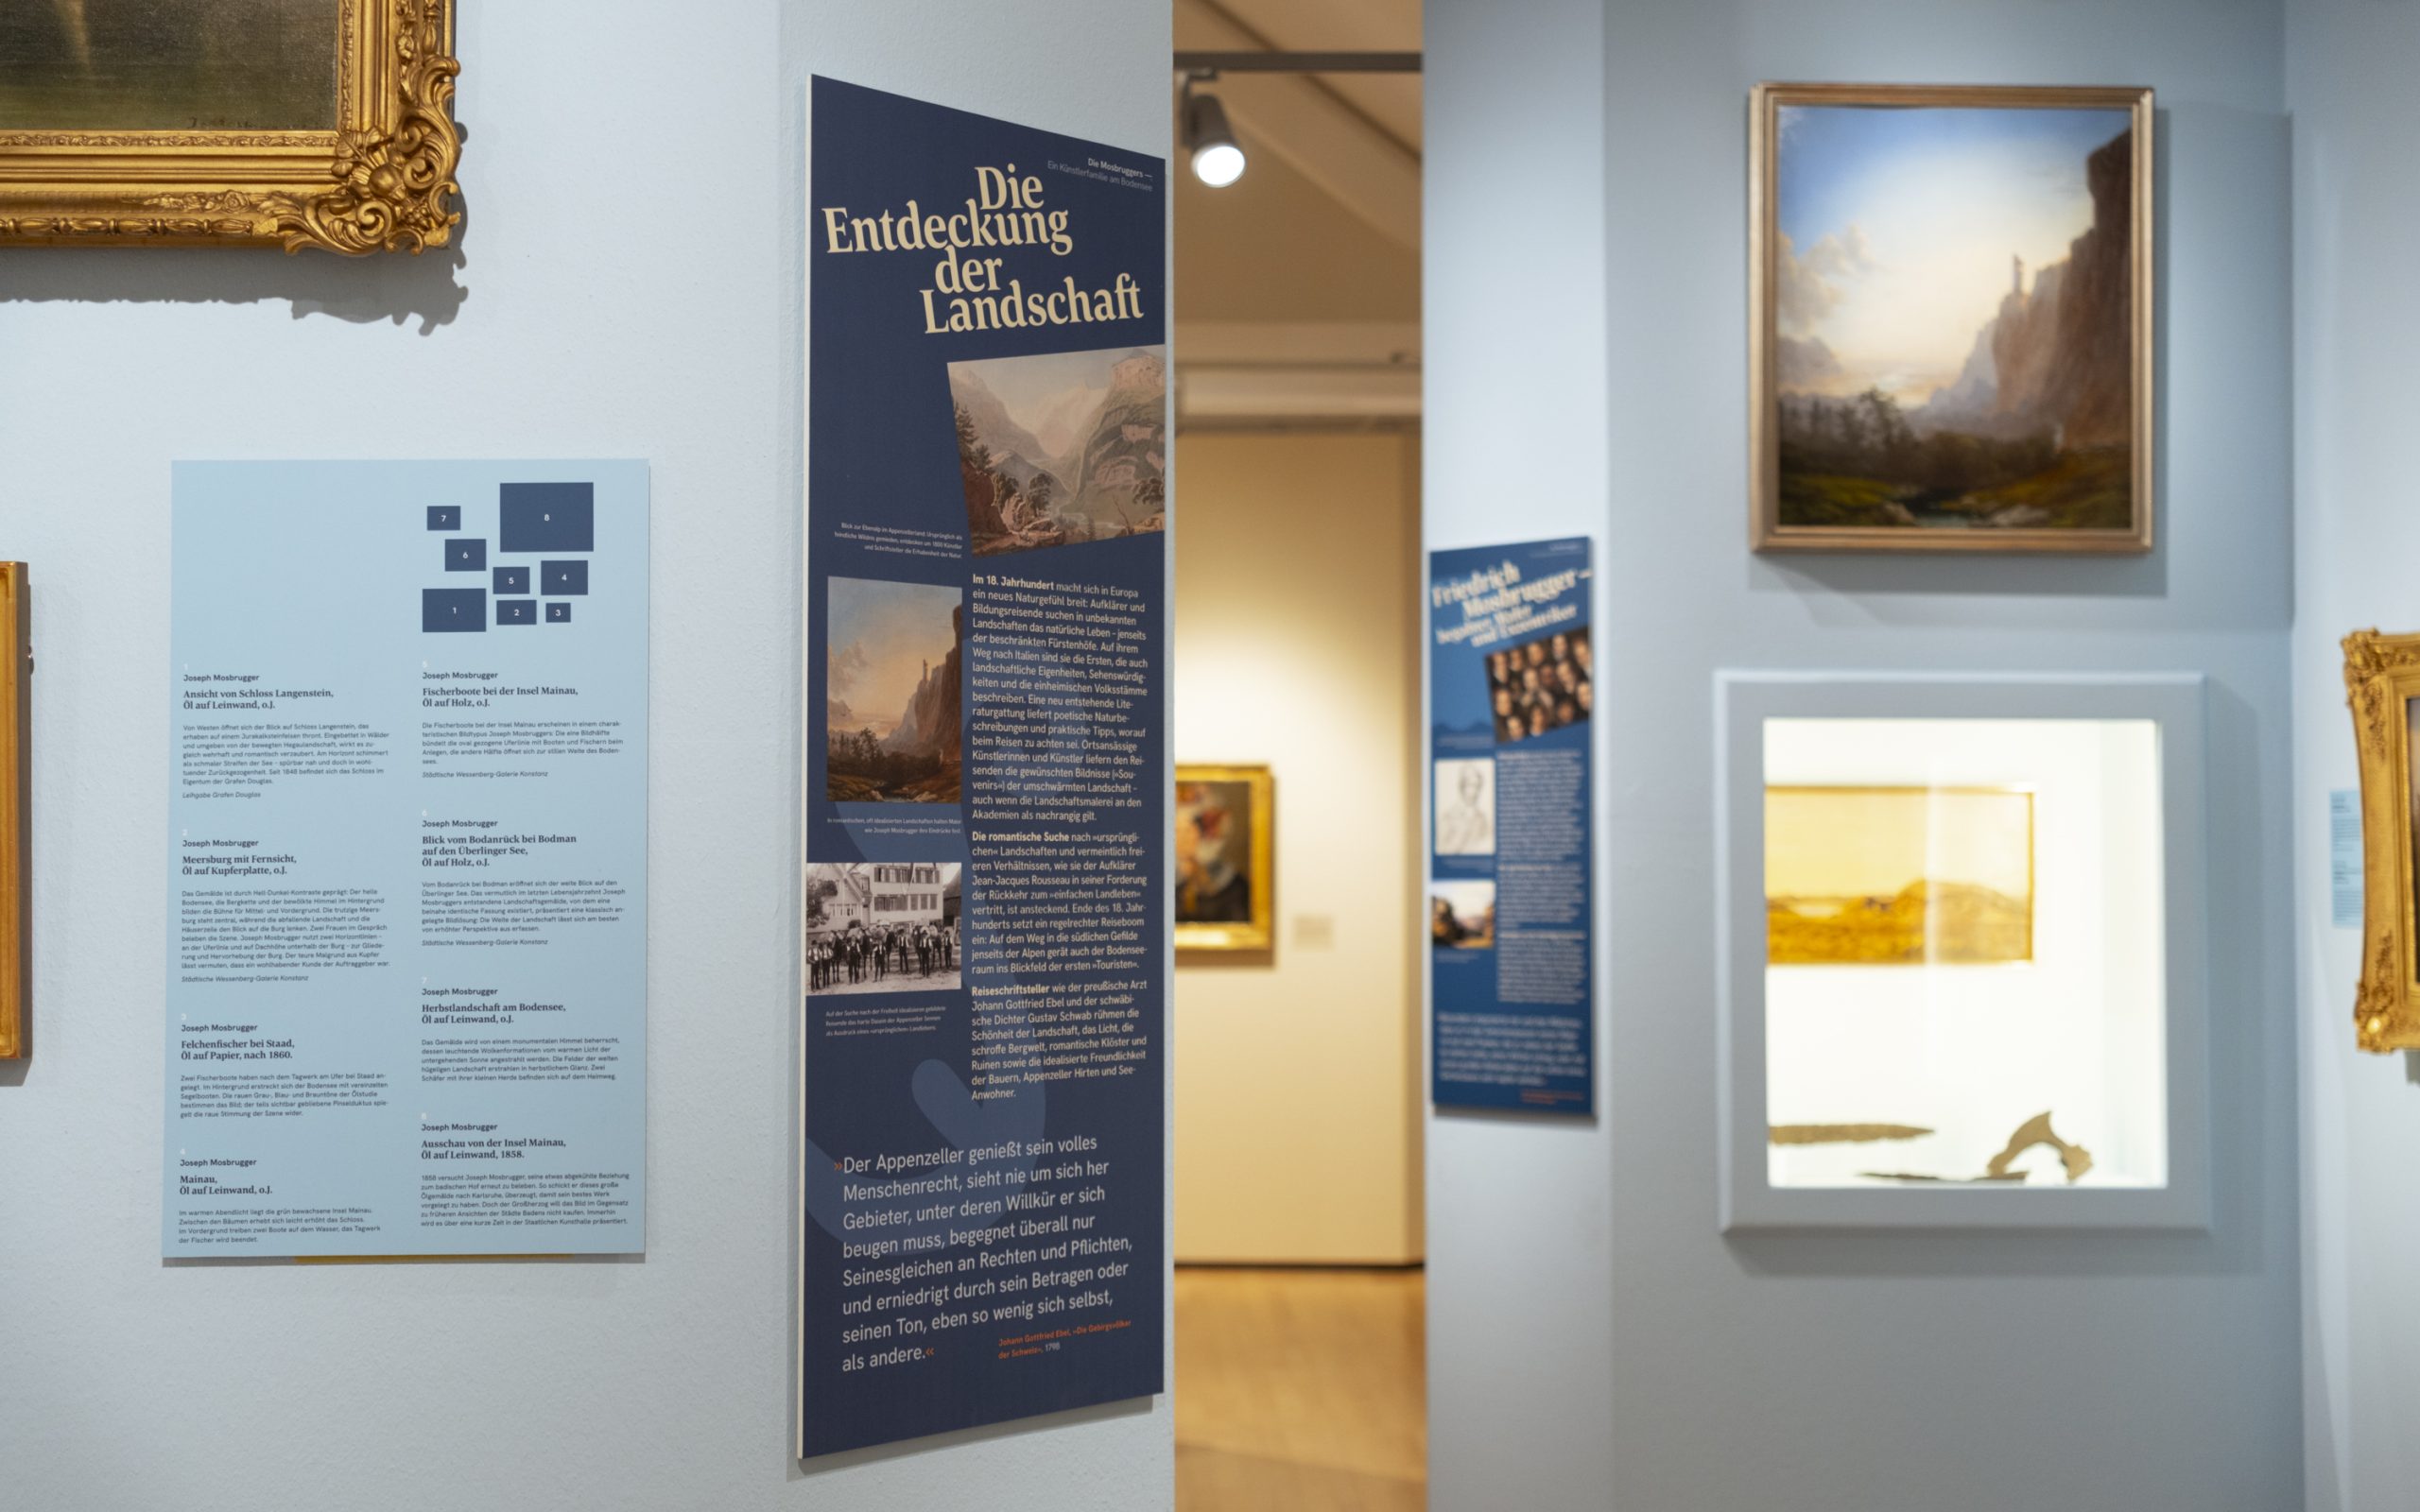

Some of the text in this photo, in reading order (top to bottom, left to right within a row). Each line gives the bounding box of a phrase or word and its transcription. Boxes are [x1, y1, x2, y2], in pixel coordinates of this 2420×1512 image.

[1087, 157, 1099, 168] Die
[1099, 160, 1144, 178] Mosbruggers
[975, 163, 1045, 210] Die
[1109, 176, 1120, 184] am
[1120, 176, 1153, 192] Bodensee
[821, 198, 1073, 256] Entdeckung
[935, 244, 1003, 294] der
[919, 273, 1144, 334] Landschaft
[544, 513, 550, 522] 8
[508, 576, 514, 585] 5
[973, 574, 984, 584] Im
[986, 575, 999, 586] 18.
[1000, 576, 1054, 591] Jahrhundert
[1056, 582, 1081, 593] macht
[1083, 584, 1099, 594] sich
[1110, 585, 1138, 599] Europa
[972, 590, 986, 599] ein
[987, 592, 1013, 602] neues
[1015, 593, 1064, 607] Naturgefühl
[1089, 598, 1128, 610] Aufklärer
[1130, 603, 1145, 612] und
[182, 674, 260, 683] Joseph Mosbrugger
[422, 671, 498, 680] Joseph Mosbrugger
[182, 689, 218, 698] Ansicht
[238, 688, 273, 697] Schloss
[275, 688, 334, 699] Langenstein,
[423, 685, 579, 696] Fischerboote bei der Insel Mainau,
[182, 699, 193, 710] Öl
[195, 699, 211, 710] auf
[212, 699, 260, 710] Leinwand,
[422, 697, 432, 707] Öl
[434, 697, 450, 707] auf
[451, 697, 475, 708] Holz,
[972, 831, 987, 841] Die
[988, 832, 1042, 842] romantische
[1043, 832, 1069, 842] Suche
[1071, 832, 1091, 842] nach
[182, 839, 259, 849] Joseph Mosbrugger
[182, 853, 297, 866] Meersburg mit Fernsicht,
[182, 866, 192, 875] Öl
[194, 866, 210, 875] auf
[211, 865, 272, 877] Kupferplatte,
[971, 979, 1147, 996] Reiseschriftsteller wie der preußische Arzt
[181, 1023, 258, 1033] Joseph Mosbrugger
[181, 1039, 295, 1049] Felchenfischer bei Staad,
[181, 1050, 293, 1061] Öl auf Papier, nach 1860.
[421, 1123, 498, 1132] Joseph Mosbrugger
[421, 1139, 465, 1148] Ausschau
[486, 1138, 502, 1147] der
[504, 1138, 527, 1147] Insel
[528, 1138, 566, 1147] Mainau,
[421, 1149, 525, 1160] Öl auf Leinwand, 1858.
[875, 1147, 964, 1172] Appenzeller
[968, 1141, 1022, 1165] genießt
[1026, 1138, 1053, 1156] sein
[1057, 1135, 1098, 1152] volles
[843, 1160, 1110, 1202] Menschenrecht, sieht nie um sich her
[843, 1185, 1105, 1230] Gebieter, unter deren Willkür er sich
[843, 1215, 1096, 1258] beugen muss, begegnet überall nur
[842, 1236, 1132, 1287] Seinesgleichen an Rechten und Pflichten,
[842, 1262, 1129, 1315] und erniedrigt durch sein Betragen oder
[842, 1290, 1113, 1344] seinen Ton, eben so wenig sich selbst,
[842, 1353, 865, 1372] als
